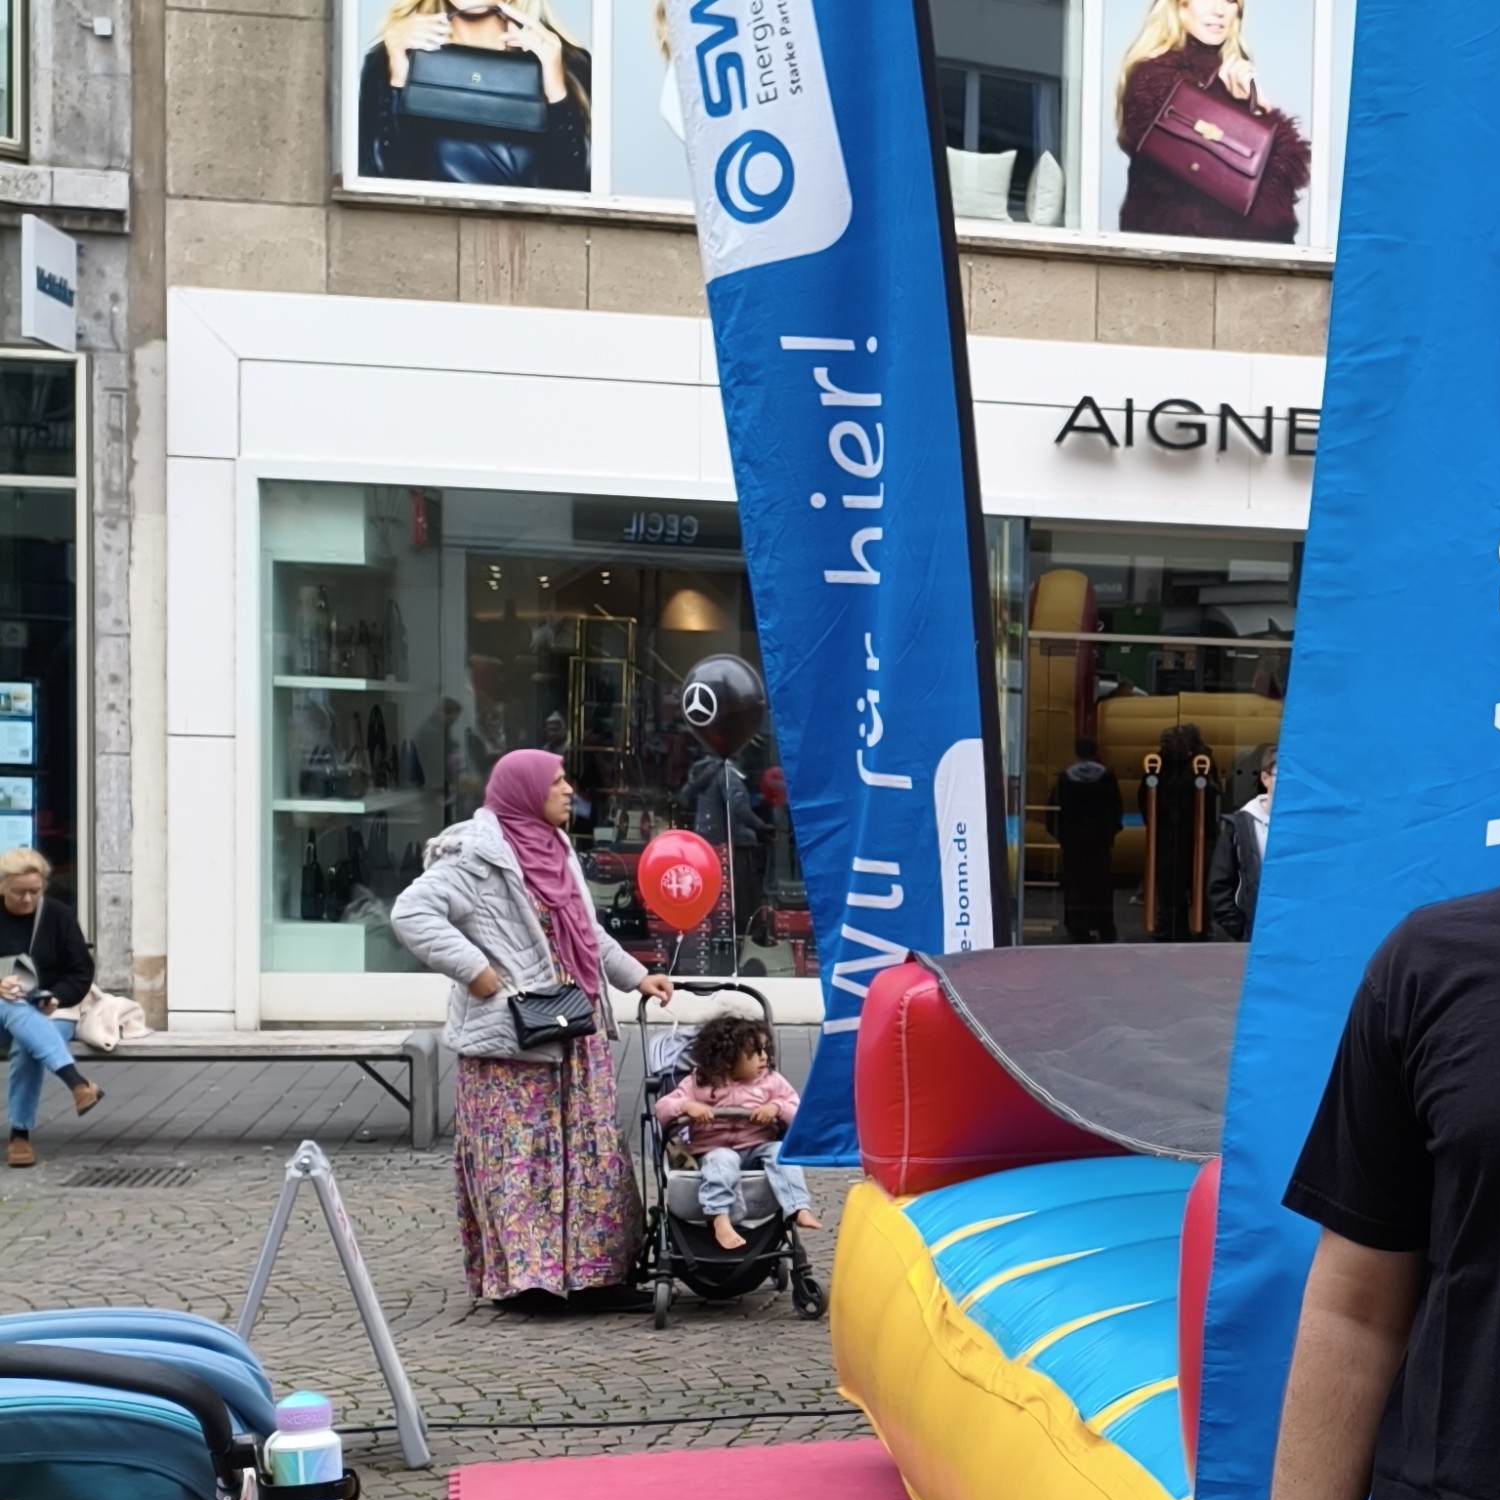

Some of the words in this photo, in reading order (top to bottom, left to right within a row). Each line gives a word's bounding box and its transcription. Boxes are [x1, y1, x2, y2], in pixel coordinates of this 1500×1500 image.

[777, 0, 791, 36] Part
[783, 41, 802, 96] Starke
[1054, 395, 1321, 456] AIGNE
[779, 336, 884, 585] hier!
